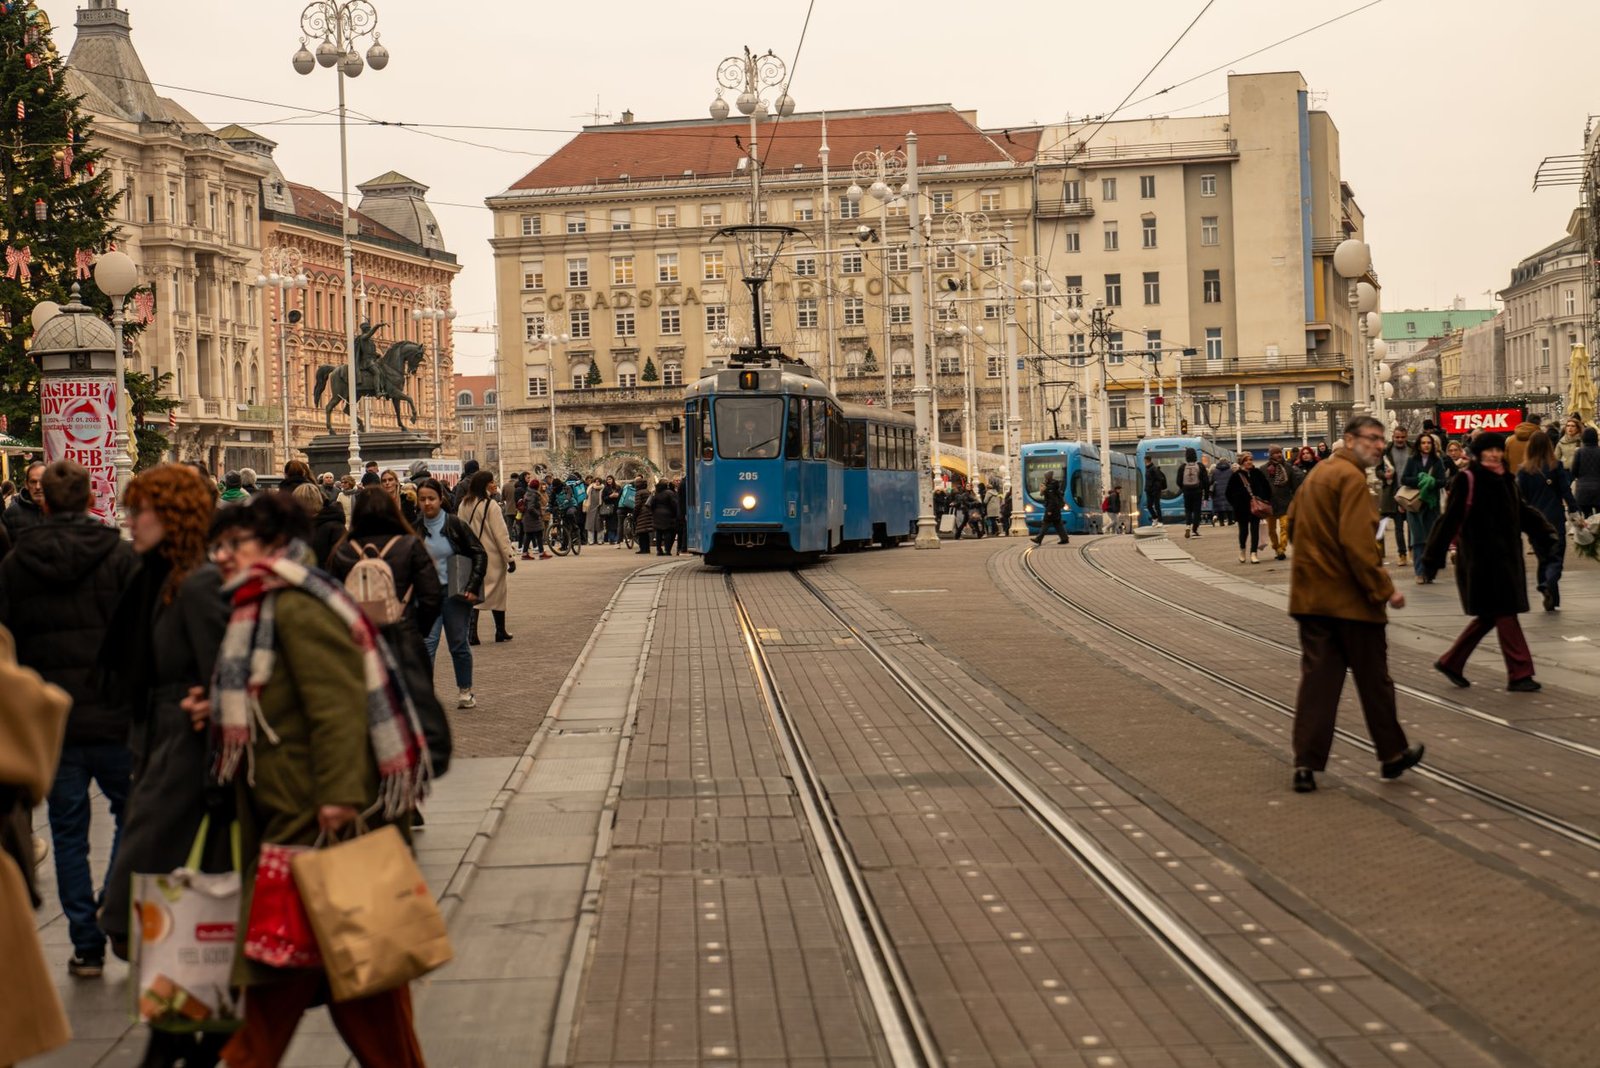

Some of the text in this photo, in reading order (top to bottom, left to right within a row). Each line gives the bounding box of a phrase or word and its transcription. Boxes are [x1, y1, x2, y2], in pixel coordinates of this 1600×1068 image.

[546, 287, 701, 312] GRADSKA
[745, 374, 753, 386] 1
[41, 382, 101, 398] AGREB
[1453, 413, 1510, 430] TISAK
[738, 471, 759, 481] 205
